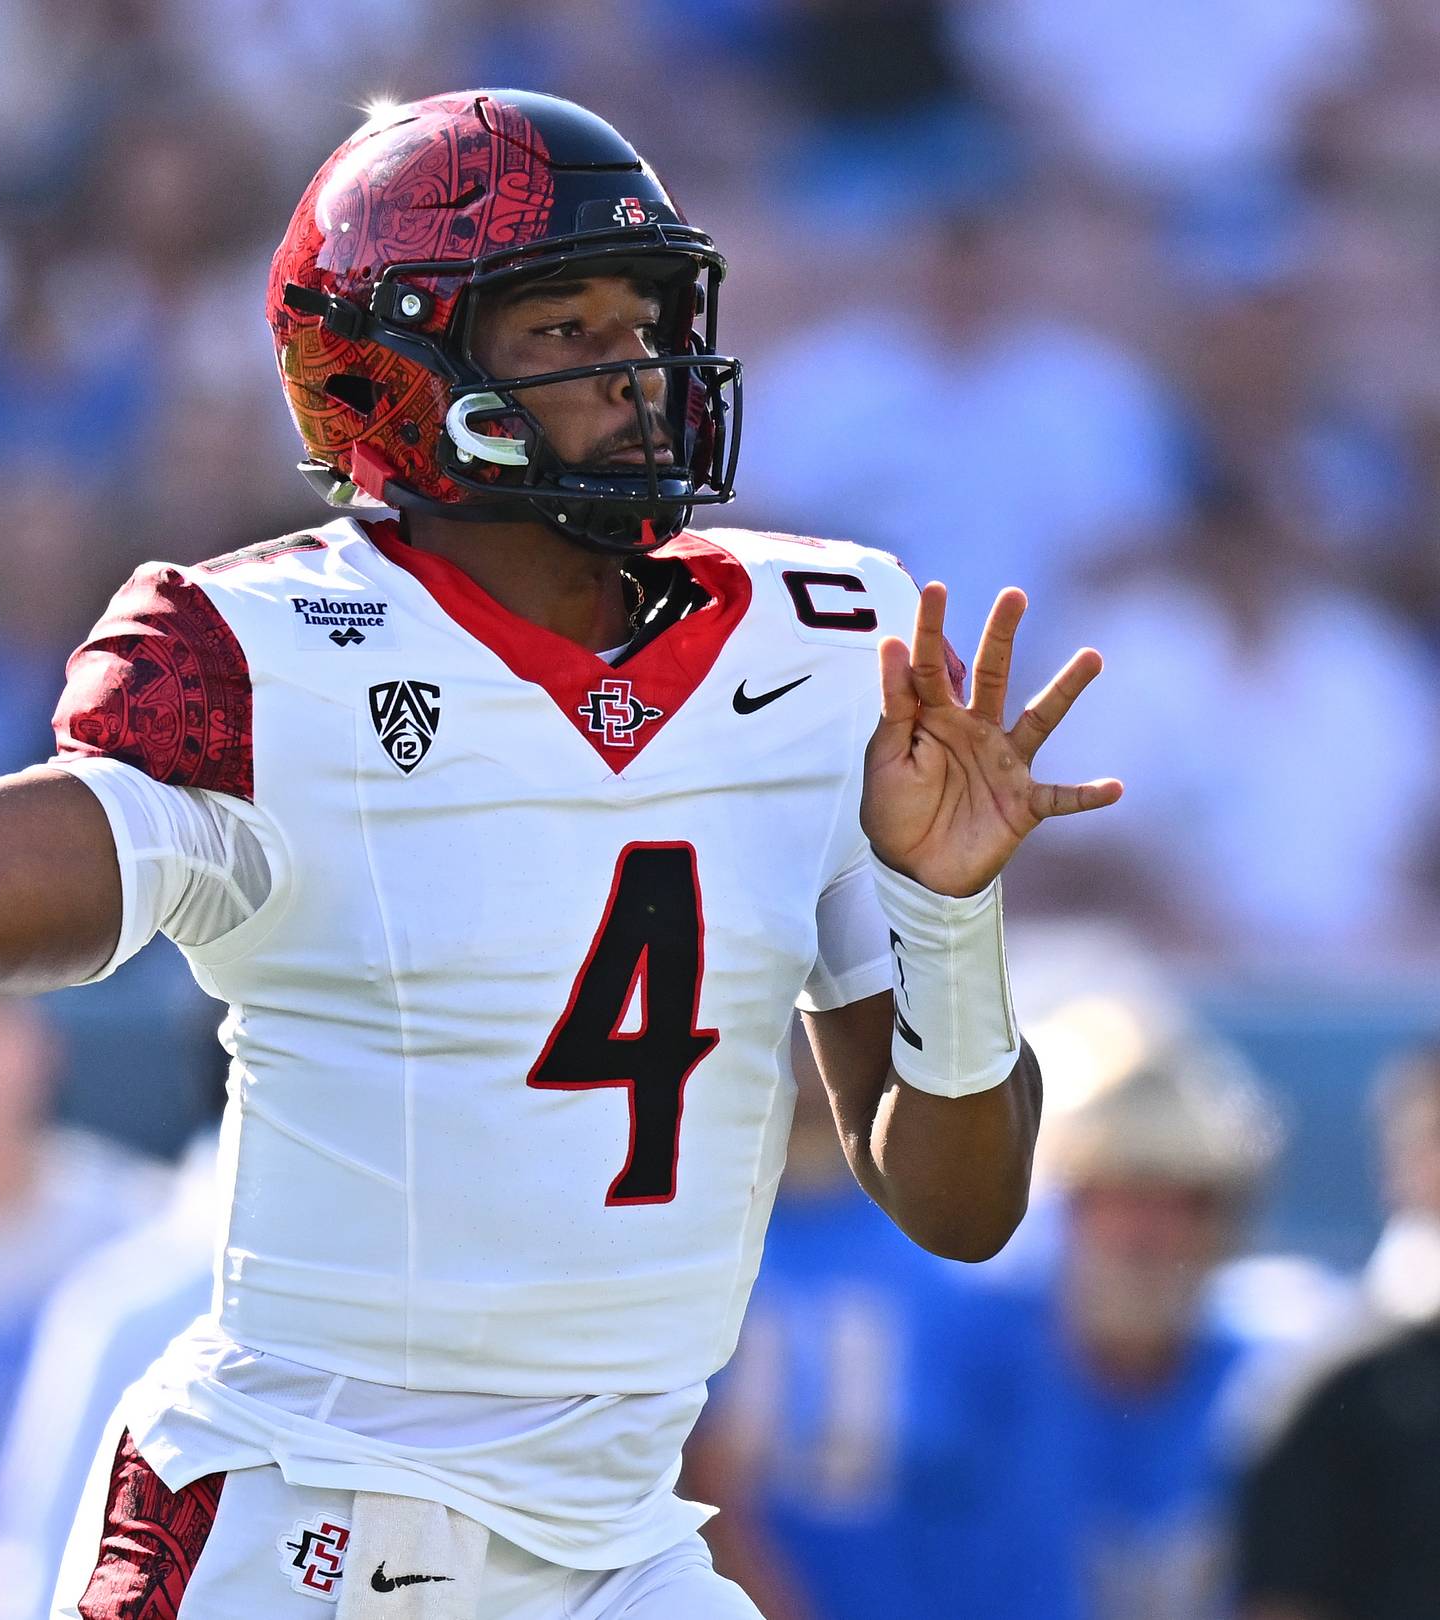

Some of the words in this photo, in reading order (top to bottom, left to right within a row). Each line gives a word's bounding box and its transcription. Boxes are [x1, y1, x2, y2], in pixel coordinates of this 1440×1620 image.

[291, 598, 387, 615] Palomar
[304, 613, 384, 626] Insurance
[782, 570, 878, 633] C
[368, 680, 440, 736] PAC
[396, 741, 417, 759] 12
[526, 841, 720, 1207] 4
